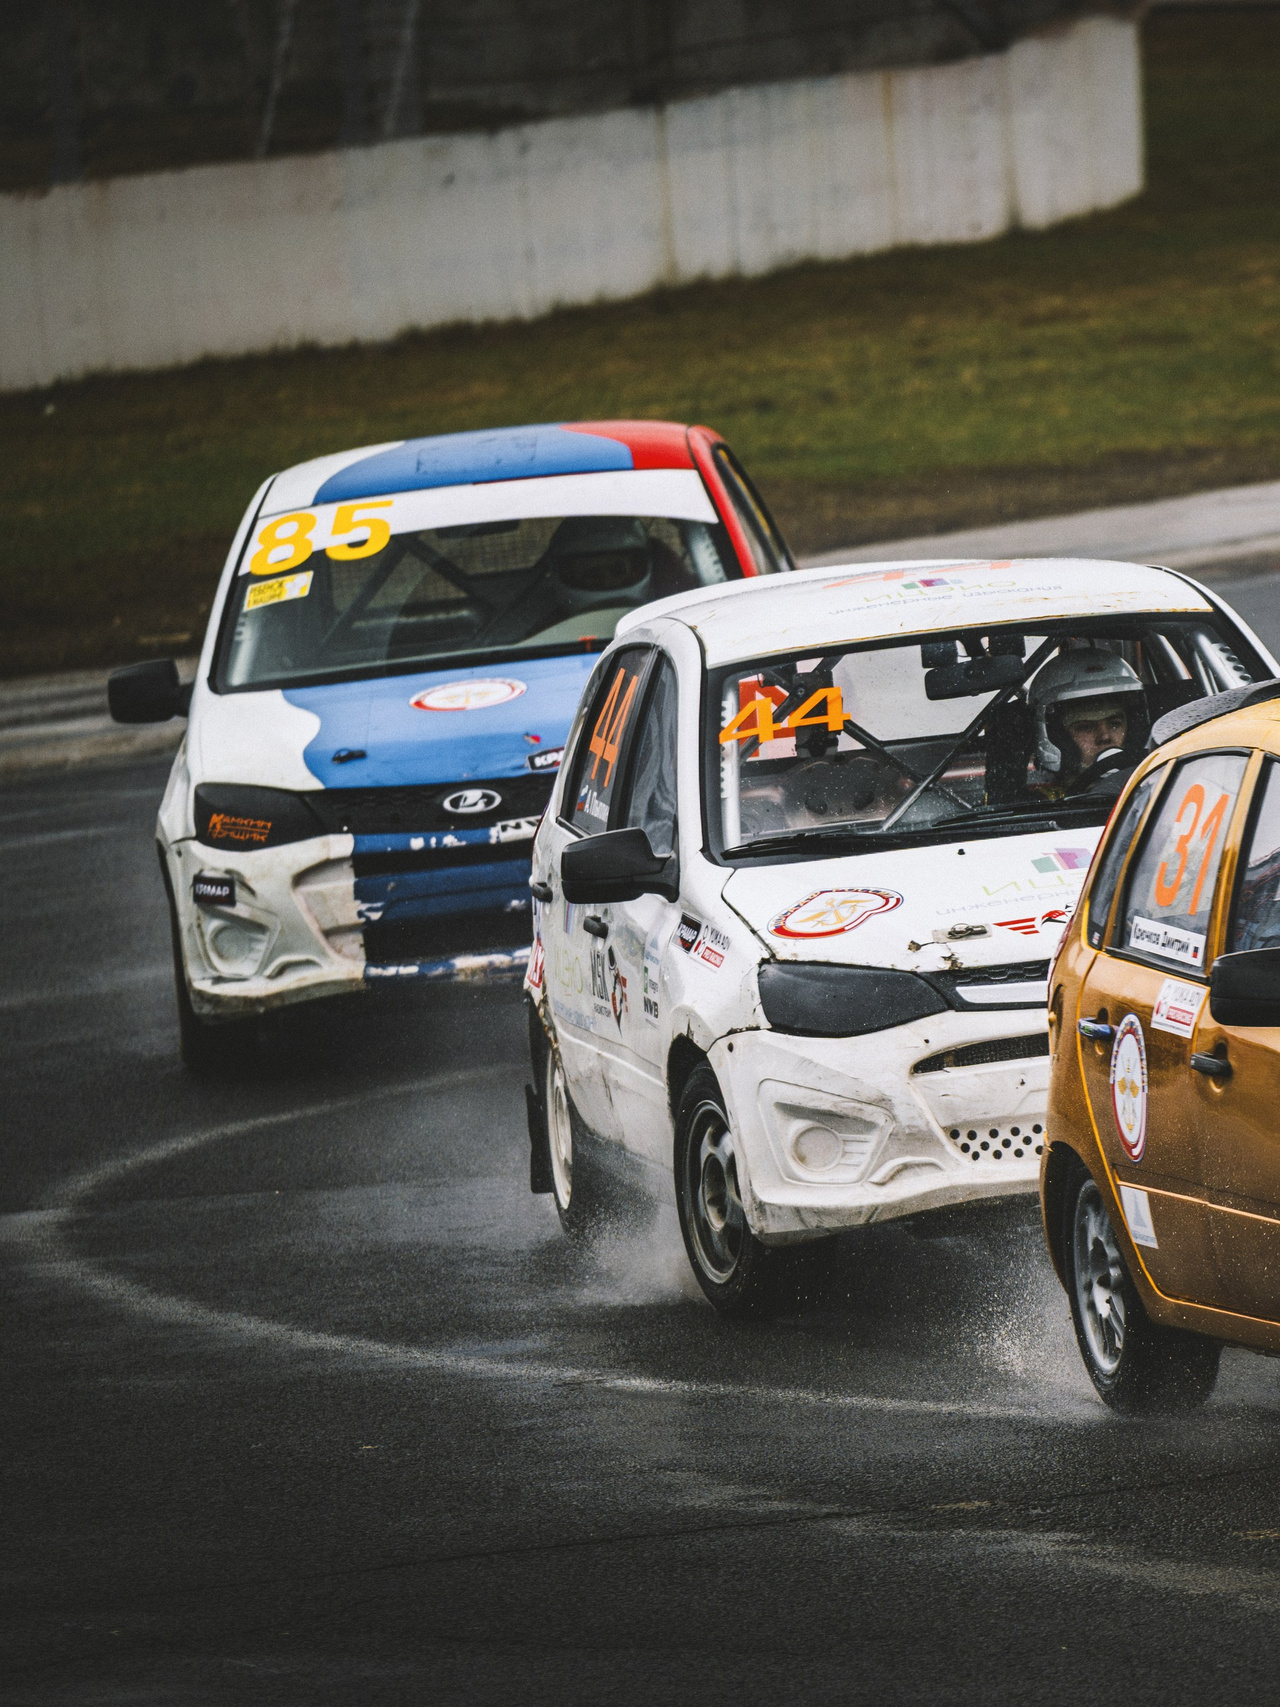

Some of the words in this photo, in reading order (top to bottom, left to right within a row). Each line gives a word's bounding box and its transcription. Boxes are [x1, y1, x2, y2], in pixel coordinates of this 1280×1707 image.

[249, 499, 394, 576] 85
[589, 667, 638, 788] 44
[718, 686, 852, 744] 44
[1155, 784, 1231, 916] 31
